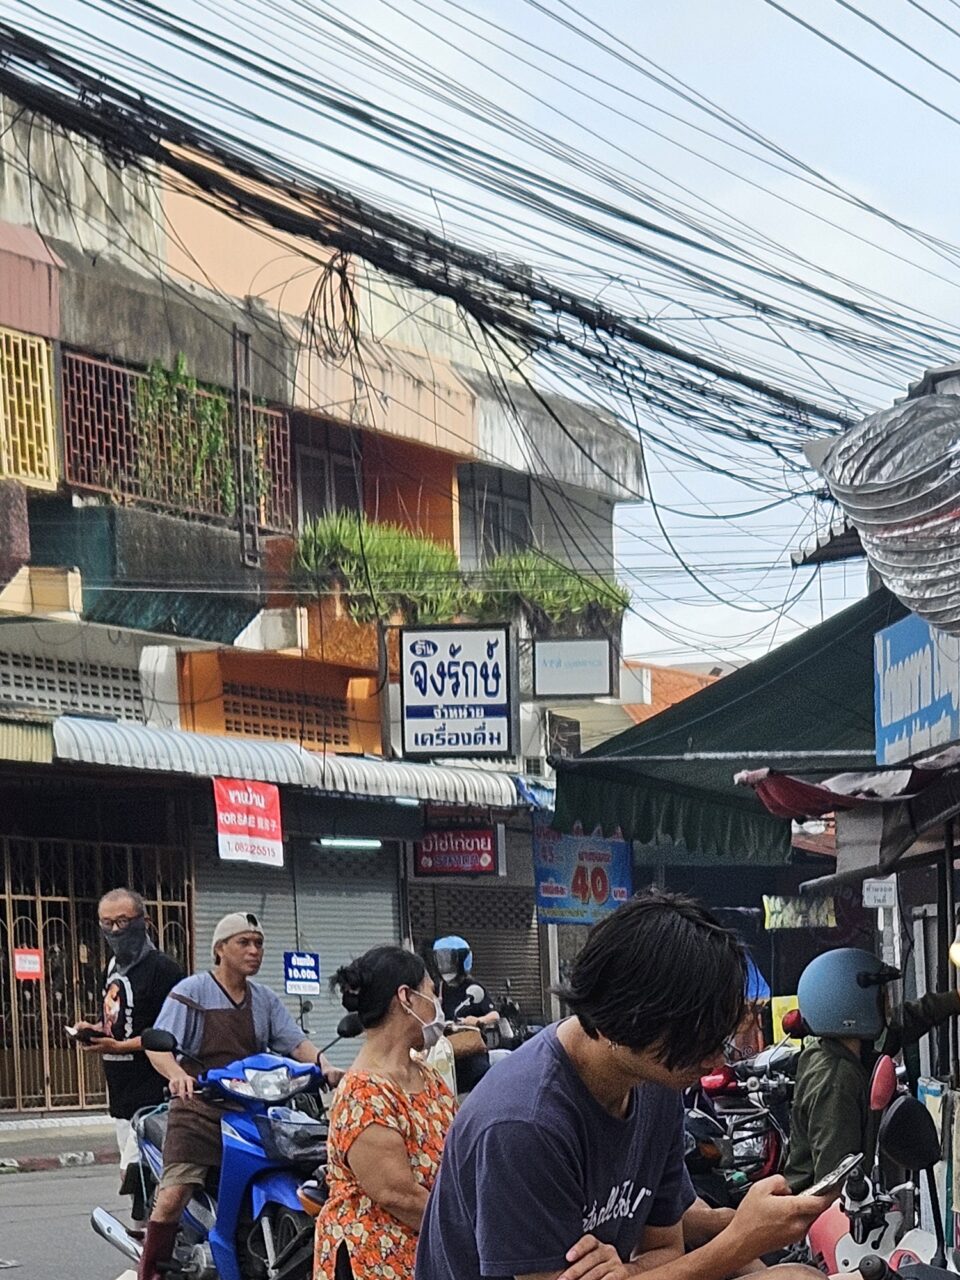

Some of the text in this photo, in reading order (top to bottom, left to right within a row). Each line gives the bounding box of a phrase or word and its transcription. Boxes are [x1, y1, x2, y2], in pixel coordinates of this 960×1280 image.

[410, 638, 502, 698] จงรักษ์
[433, 704, 485, 720] จำหน่าย
[414, 721, 502, 746] เครื่องดื่ม
[570, 864, 610, 905] 40
